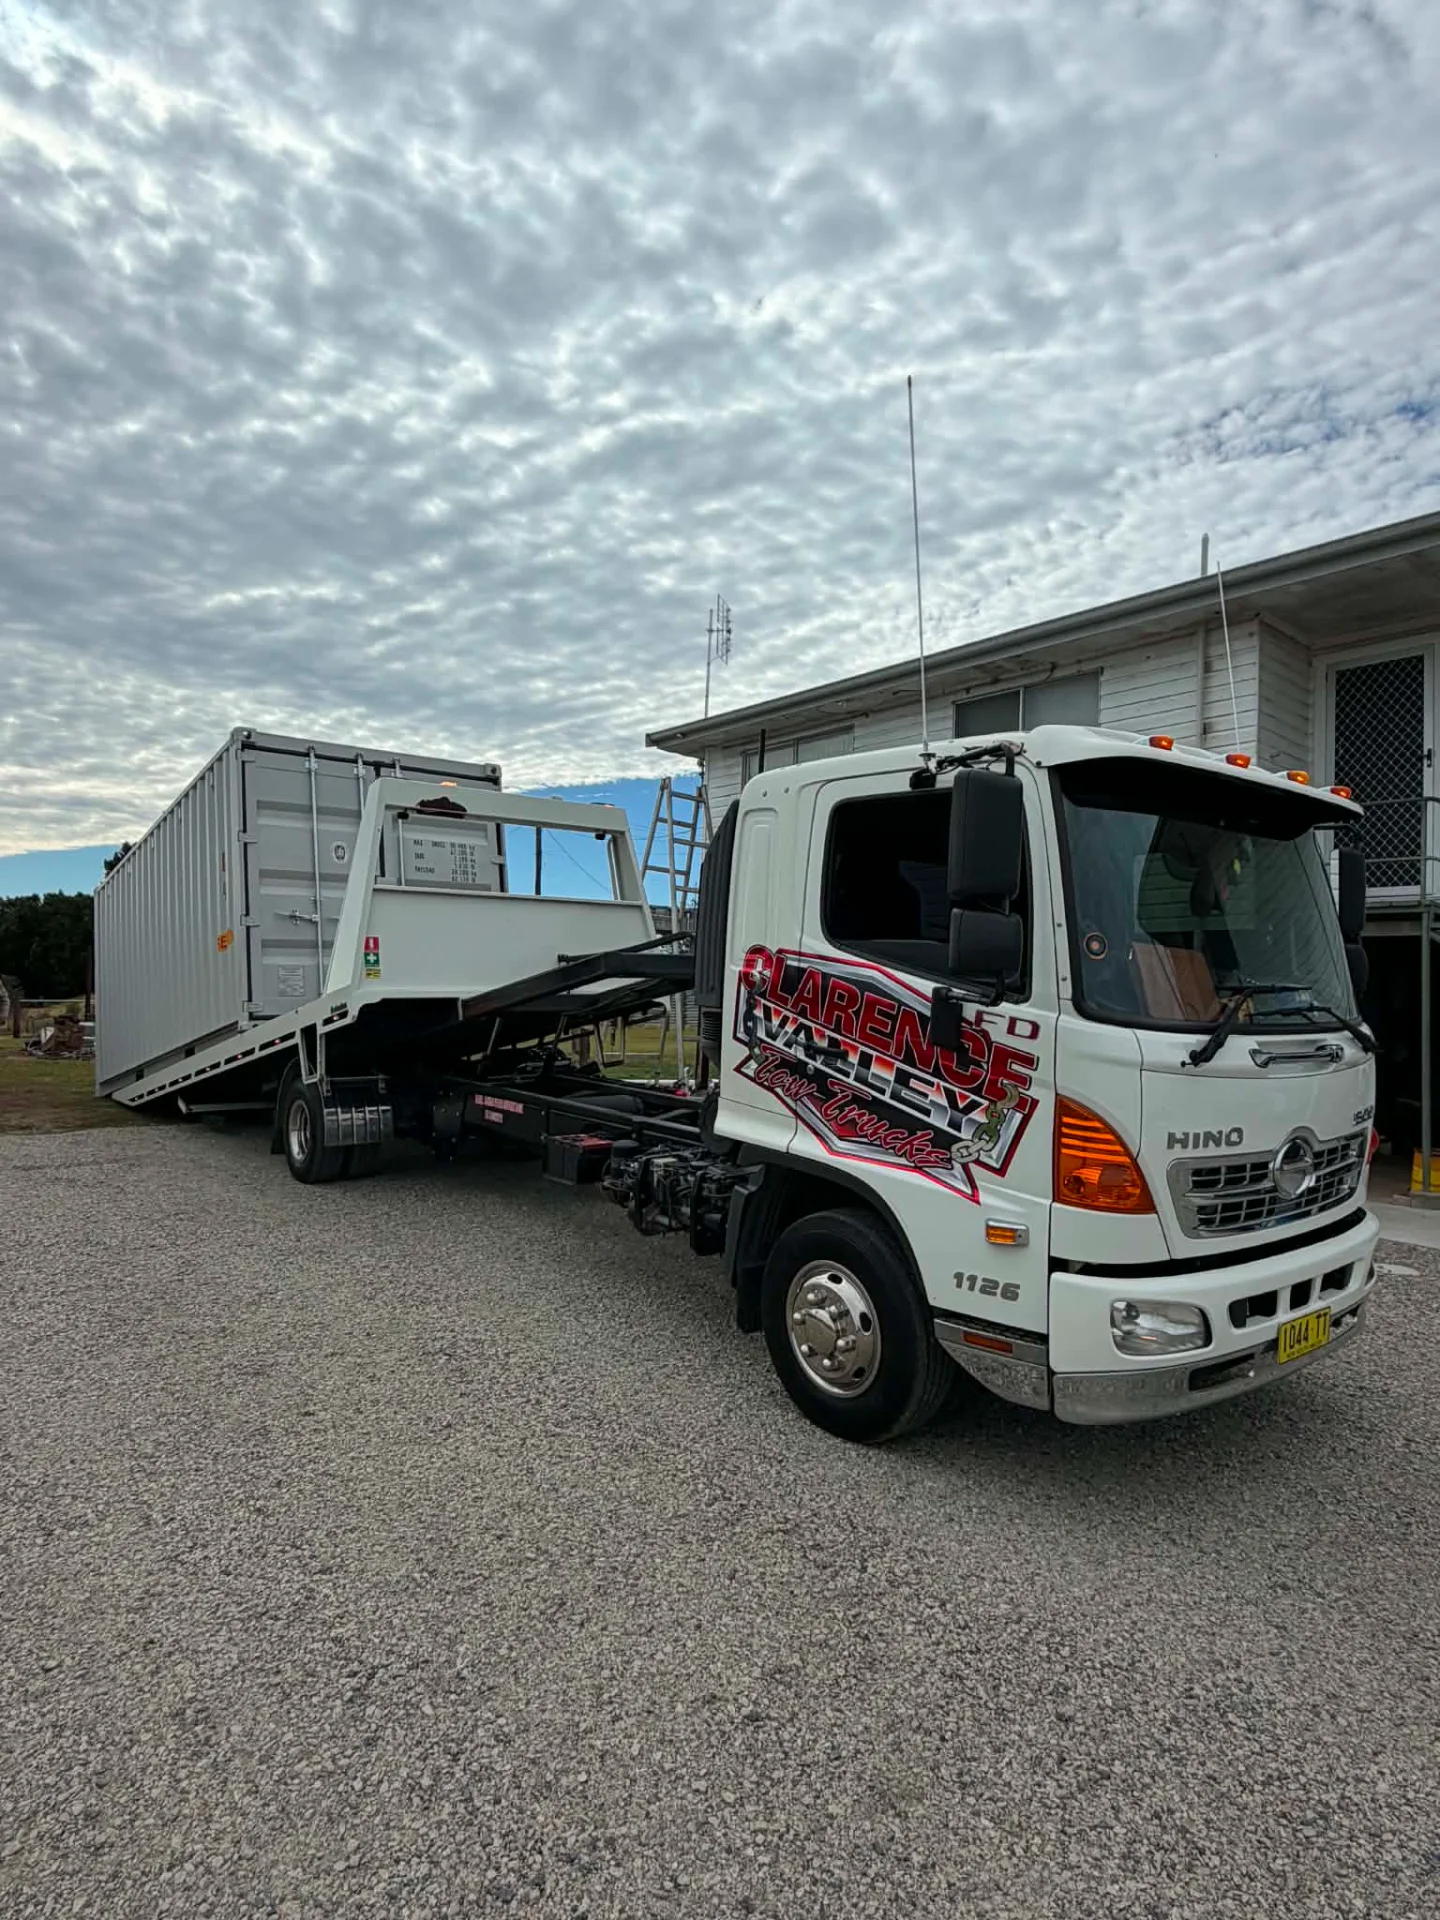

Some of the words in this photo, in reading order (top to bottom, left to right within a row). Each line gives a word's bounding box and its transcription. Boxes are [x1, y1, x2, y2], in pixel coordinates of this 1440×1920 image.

[742, 944, 1040, 1115] CLARENCE
[821, 1078, 954, 1170] Trucks
[1166, 1126, 1245, 1150] HINO
[953, 1271, 1021, 1302] 1126
